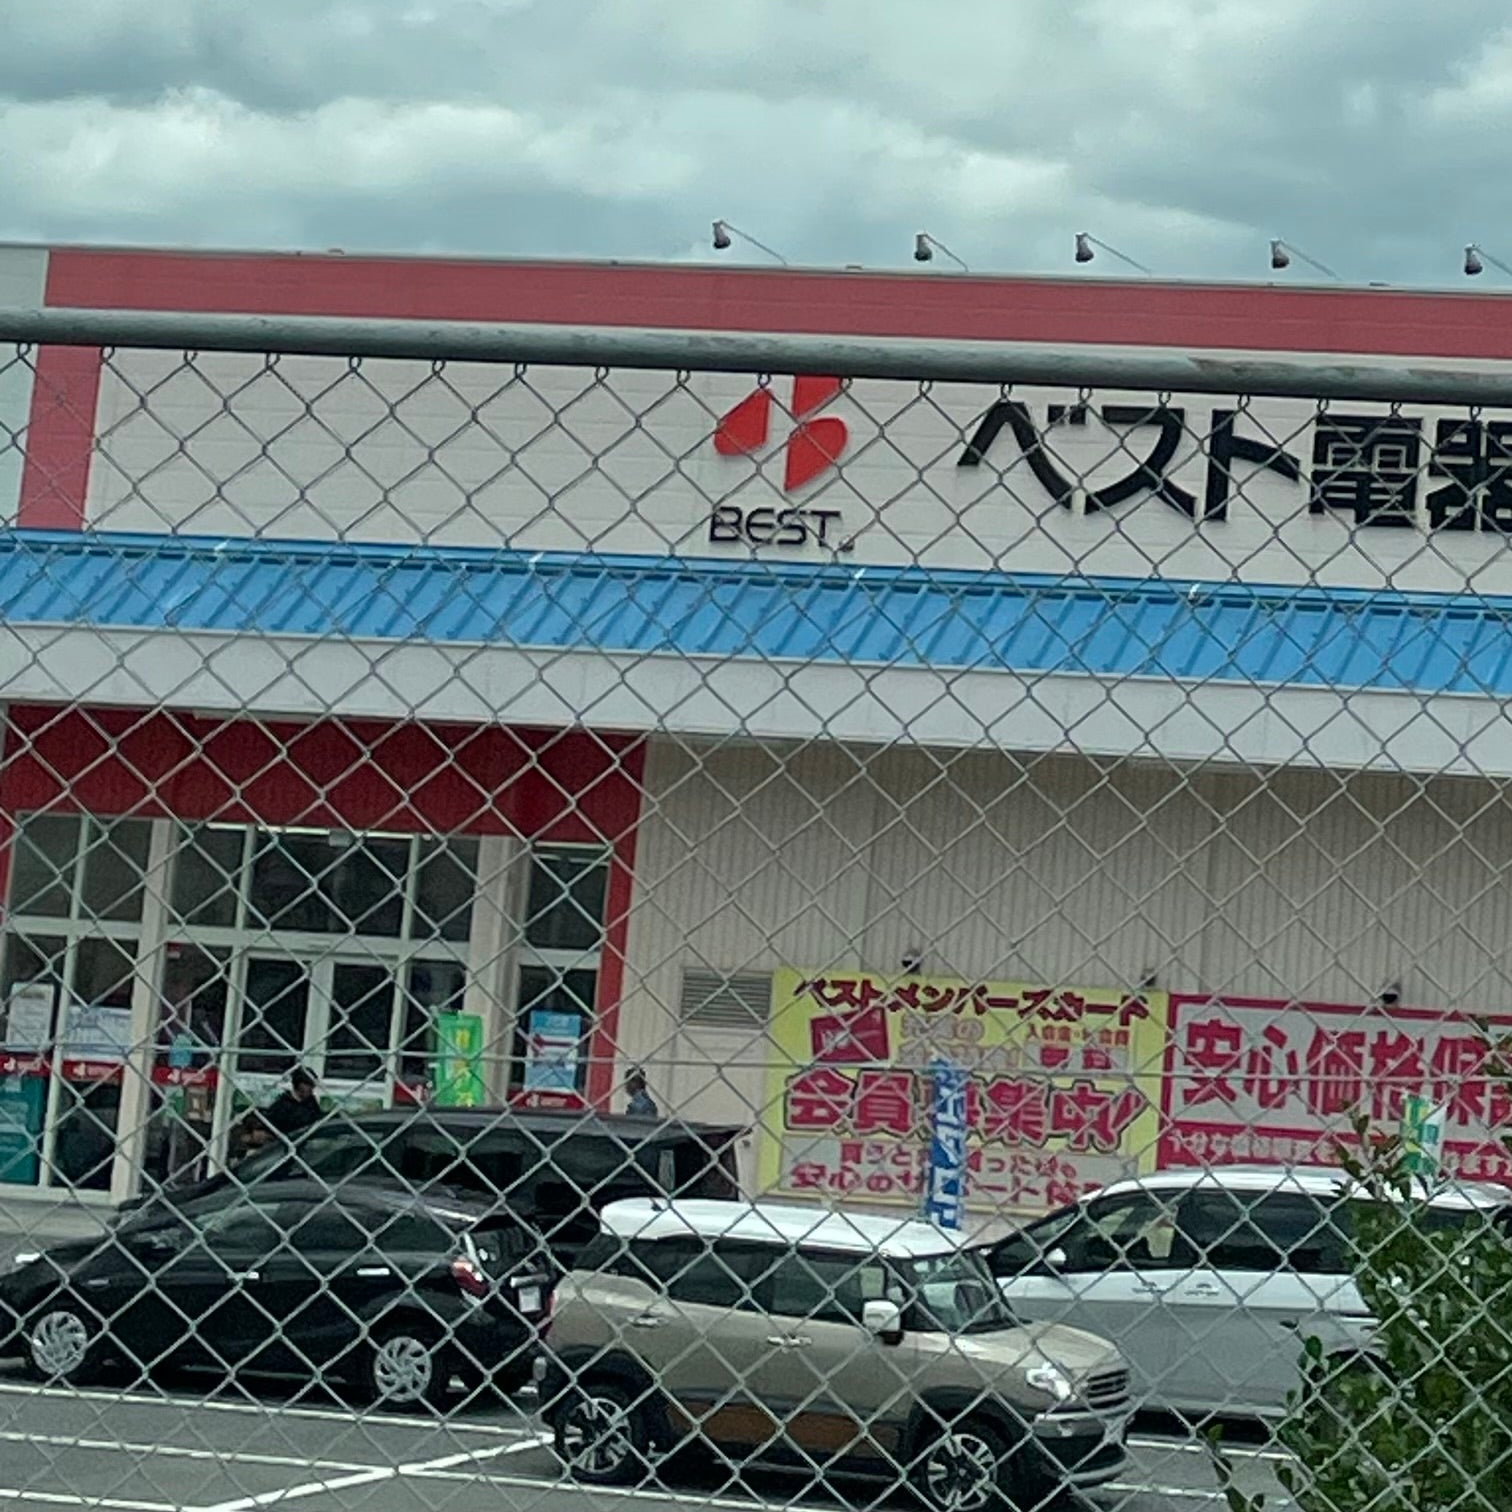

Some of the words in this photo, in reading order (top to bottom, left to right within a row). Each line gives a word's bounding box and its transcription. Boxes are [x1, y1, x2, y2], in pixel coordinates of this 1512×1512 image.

[708, 505, 845, 550] BEST
[786, 1067, 1147, 1150] 会員集中!
